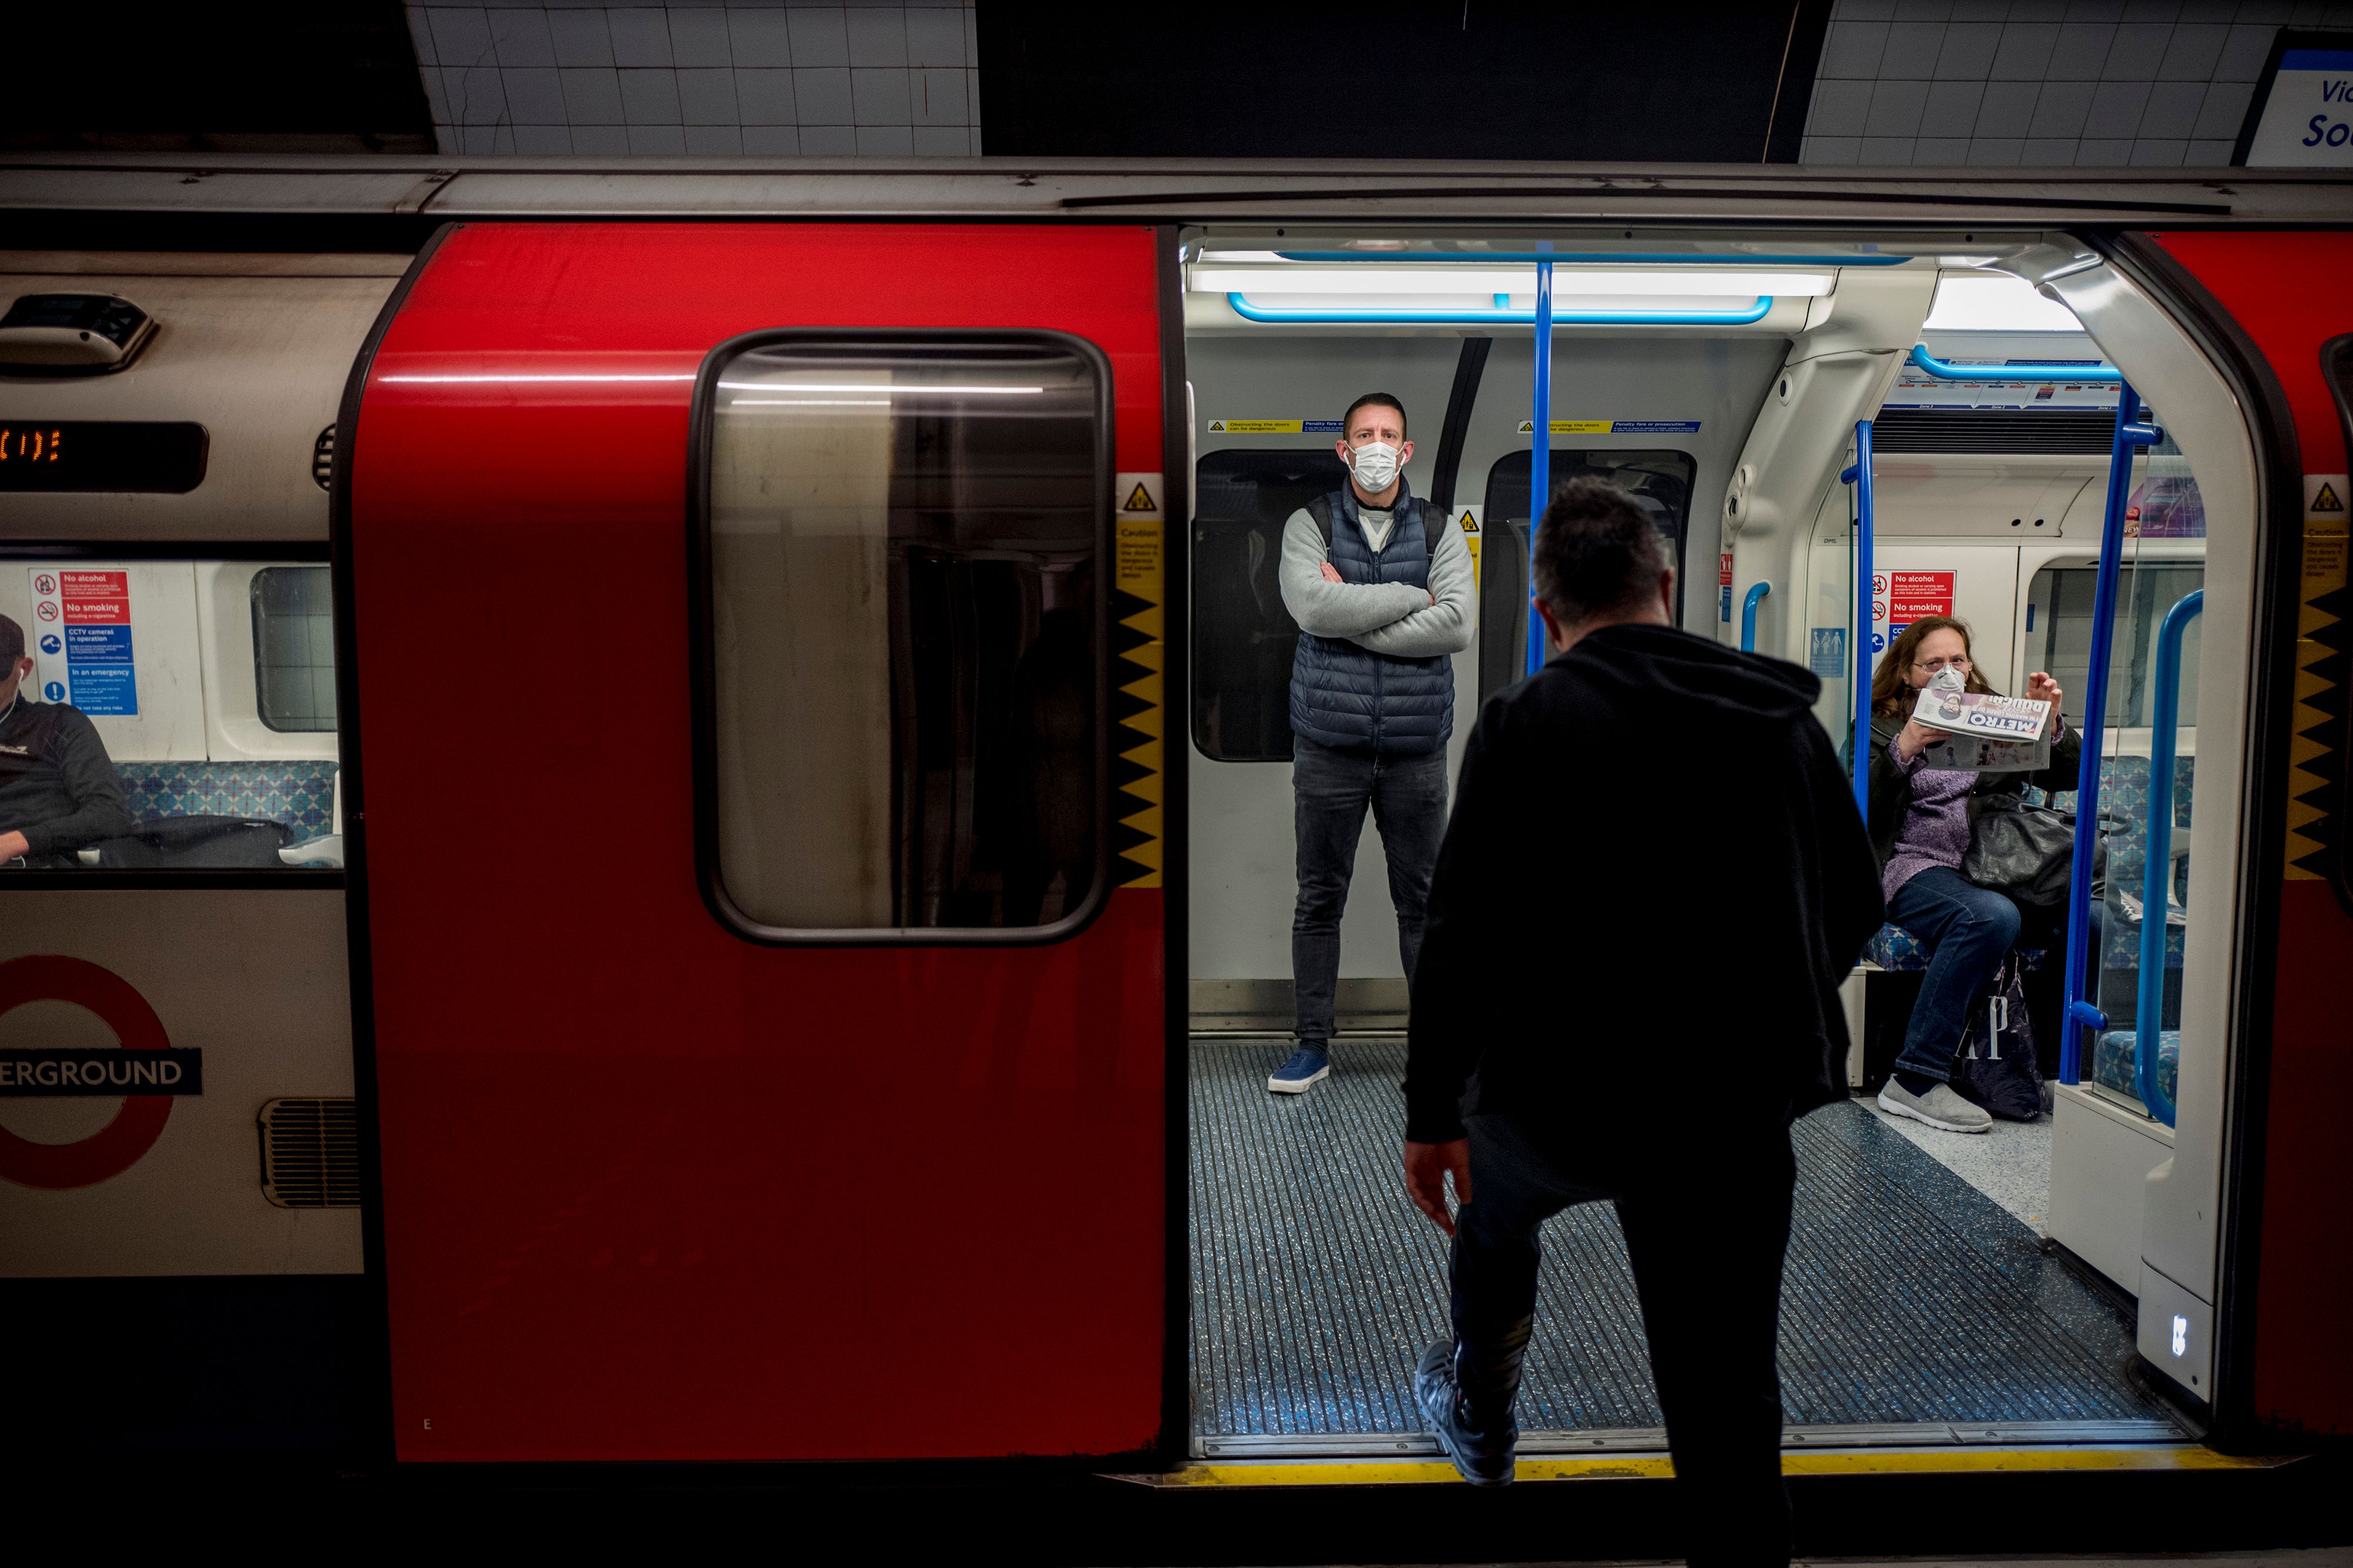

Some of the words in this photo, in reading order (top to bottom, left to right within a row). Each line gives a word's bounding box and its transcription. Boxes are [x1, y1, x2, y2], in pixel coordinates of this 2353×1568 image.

[2302, 115, 2353, 146] So
[78, 574, 106, 582] alcohol
[83, 603, 119, 613] smoking
[1909, 603, 1942, 612] smoking
[1986, 708, 2005, 716] LOADS
[1971, 713, 2034, 731] METRO
[424, 1418, 432, 1430] E
